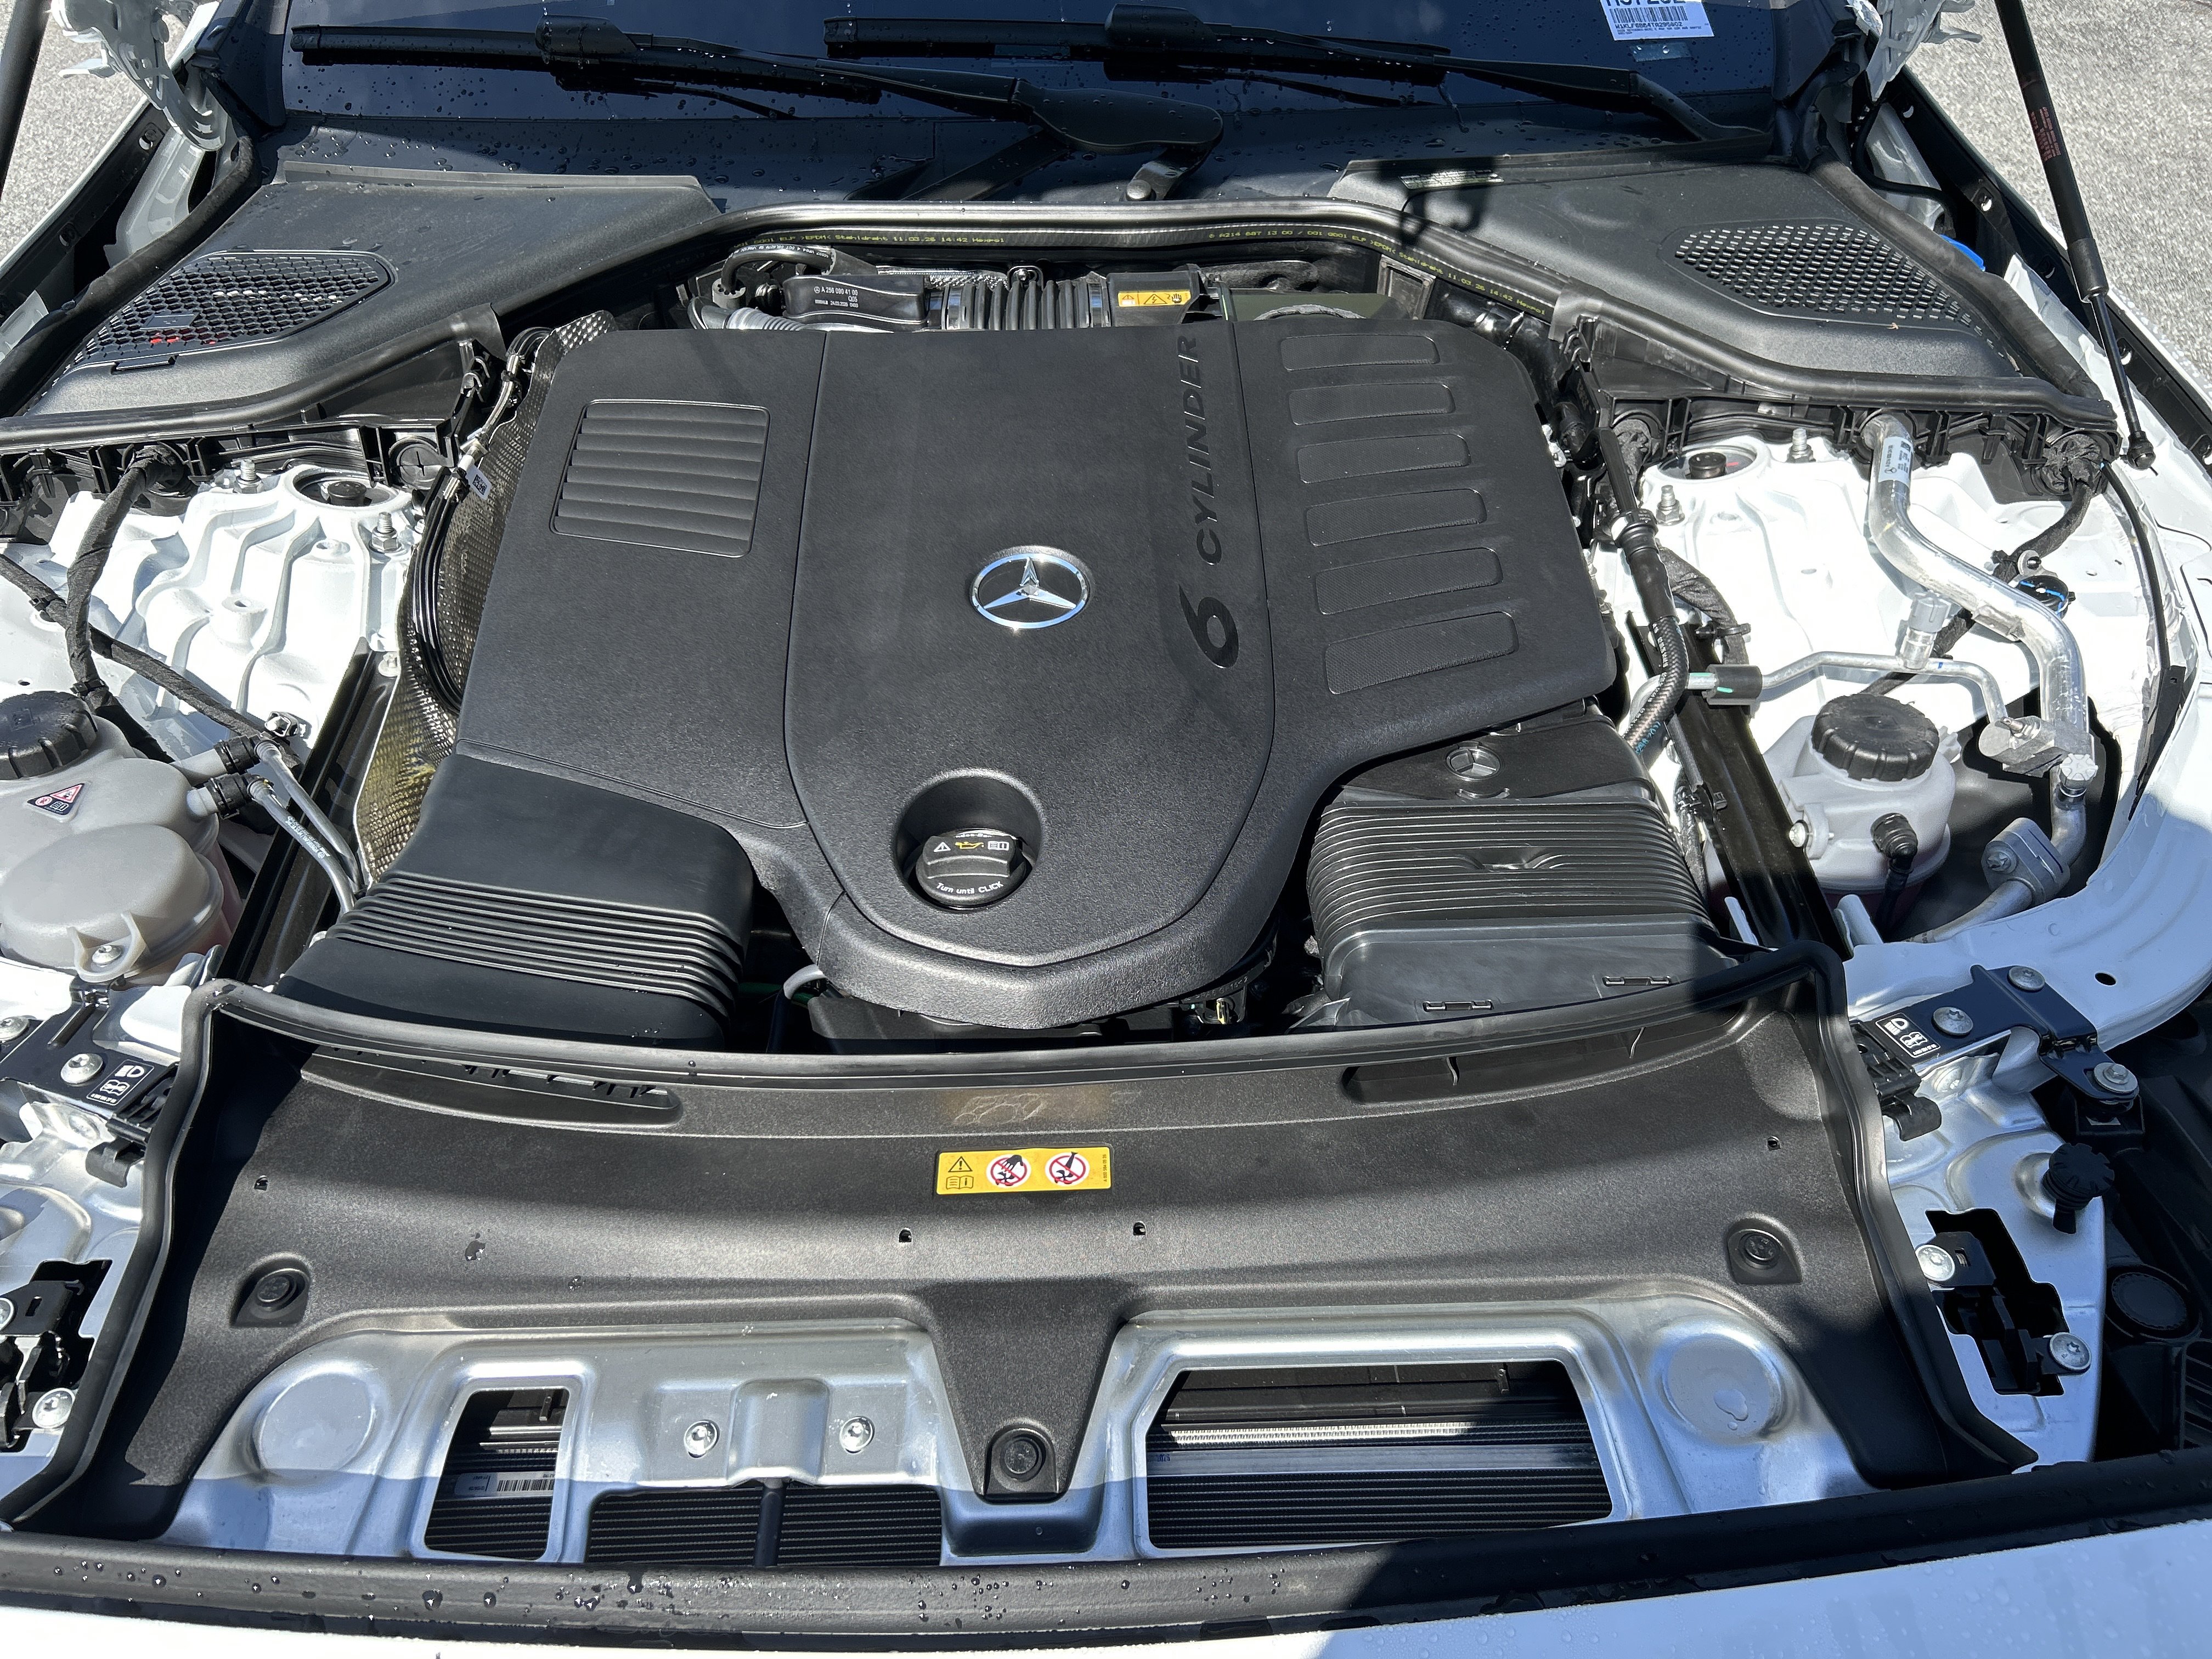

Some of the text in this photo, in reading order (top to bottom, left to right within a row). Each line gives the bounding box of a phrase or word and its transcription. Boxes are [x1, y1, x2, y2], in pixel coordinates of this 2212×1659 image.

[1489, 289, 1514, 302] 14:42
[1516, 298, 1546, 315] Hexpol
[1177, 334, 1240, 670] 6 CYLINDER
[936, 882, 954, 894] Turn
[978, 881, 1005, 893] CLICK
